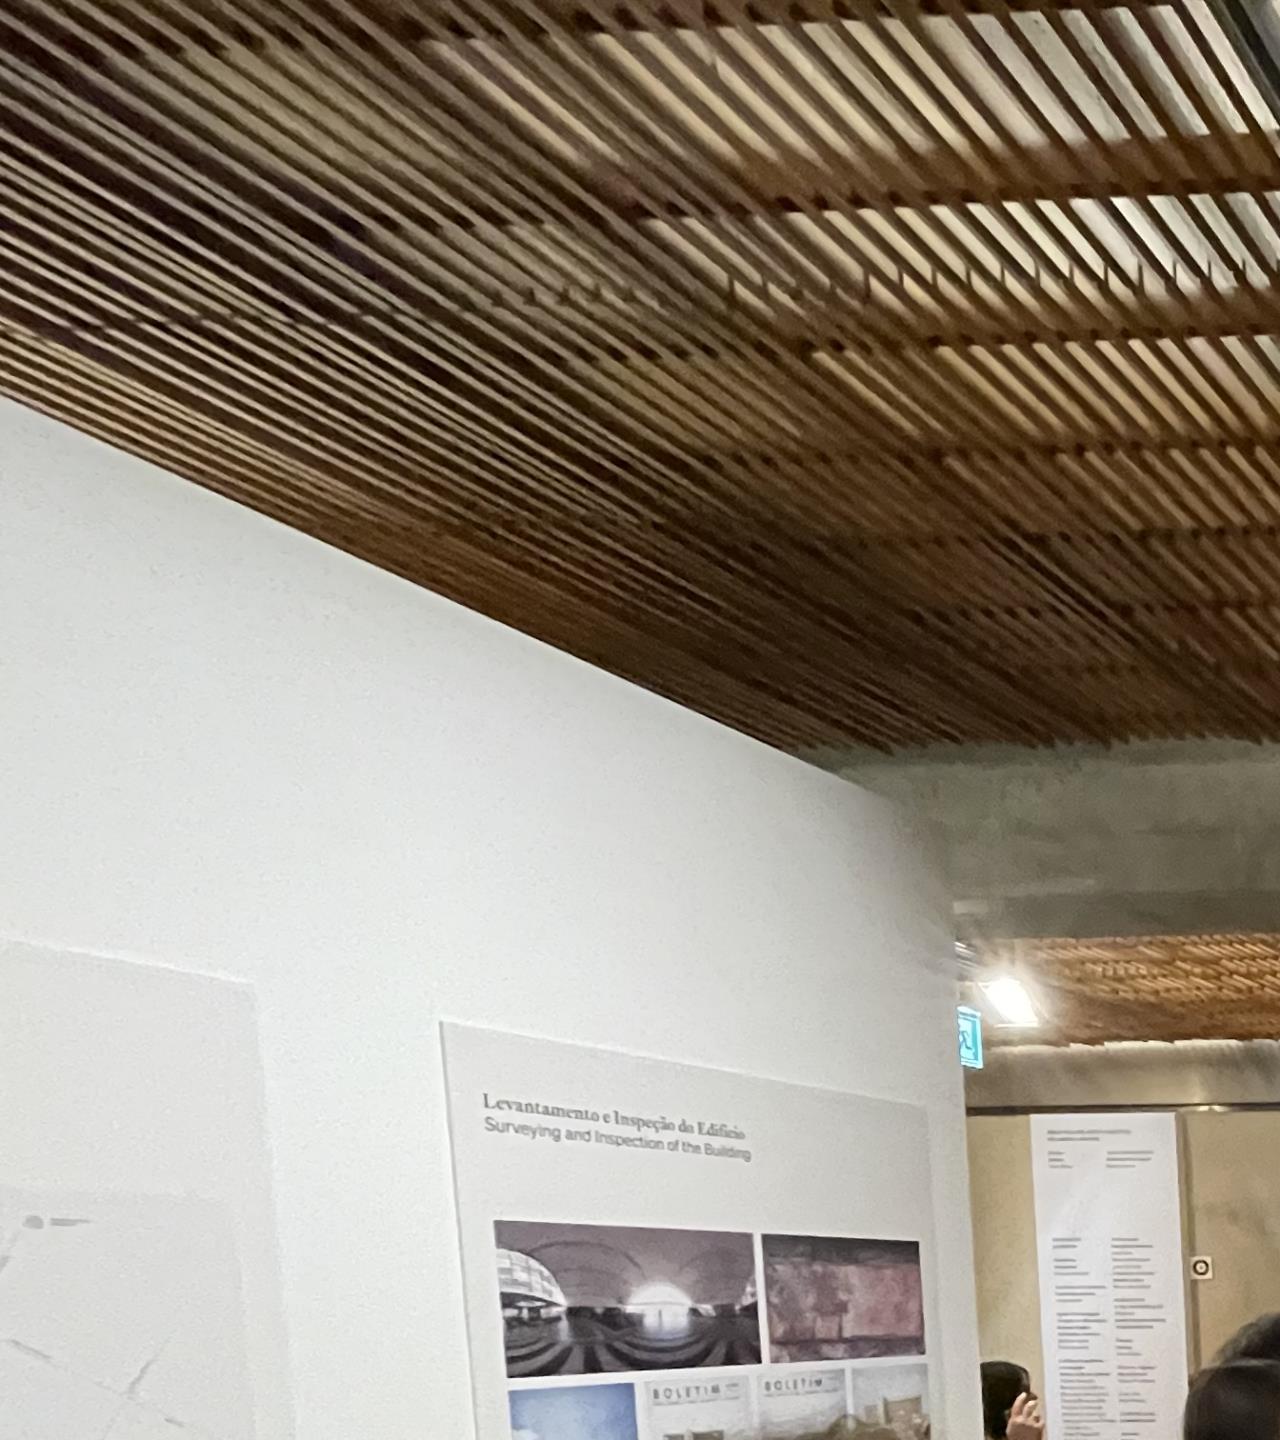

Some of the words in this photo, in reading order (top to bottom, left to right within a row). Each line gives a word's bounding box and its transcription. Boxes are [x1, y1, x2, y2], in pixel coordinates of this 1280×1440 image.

[482, 1092, 600, 1122] Levantamento
[602, 1112, 611, 1124] e
[484, 1115, 562, 1143] Surveying
[564, 1128, 592, 1143] and
[594, 1130, 665, 1152] Inspection
[667, 1139, 680, 1152] of
[681, 1141, 702, 1154] the
[703, 1142, 752, 1163] Building
[652, 1383, 721, 1401] BOLETIM
